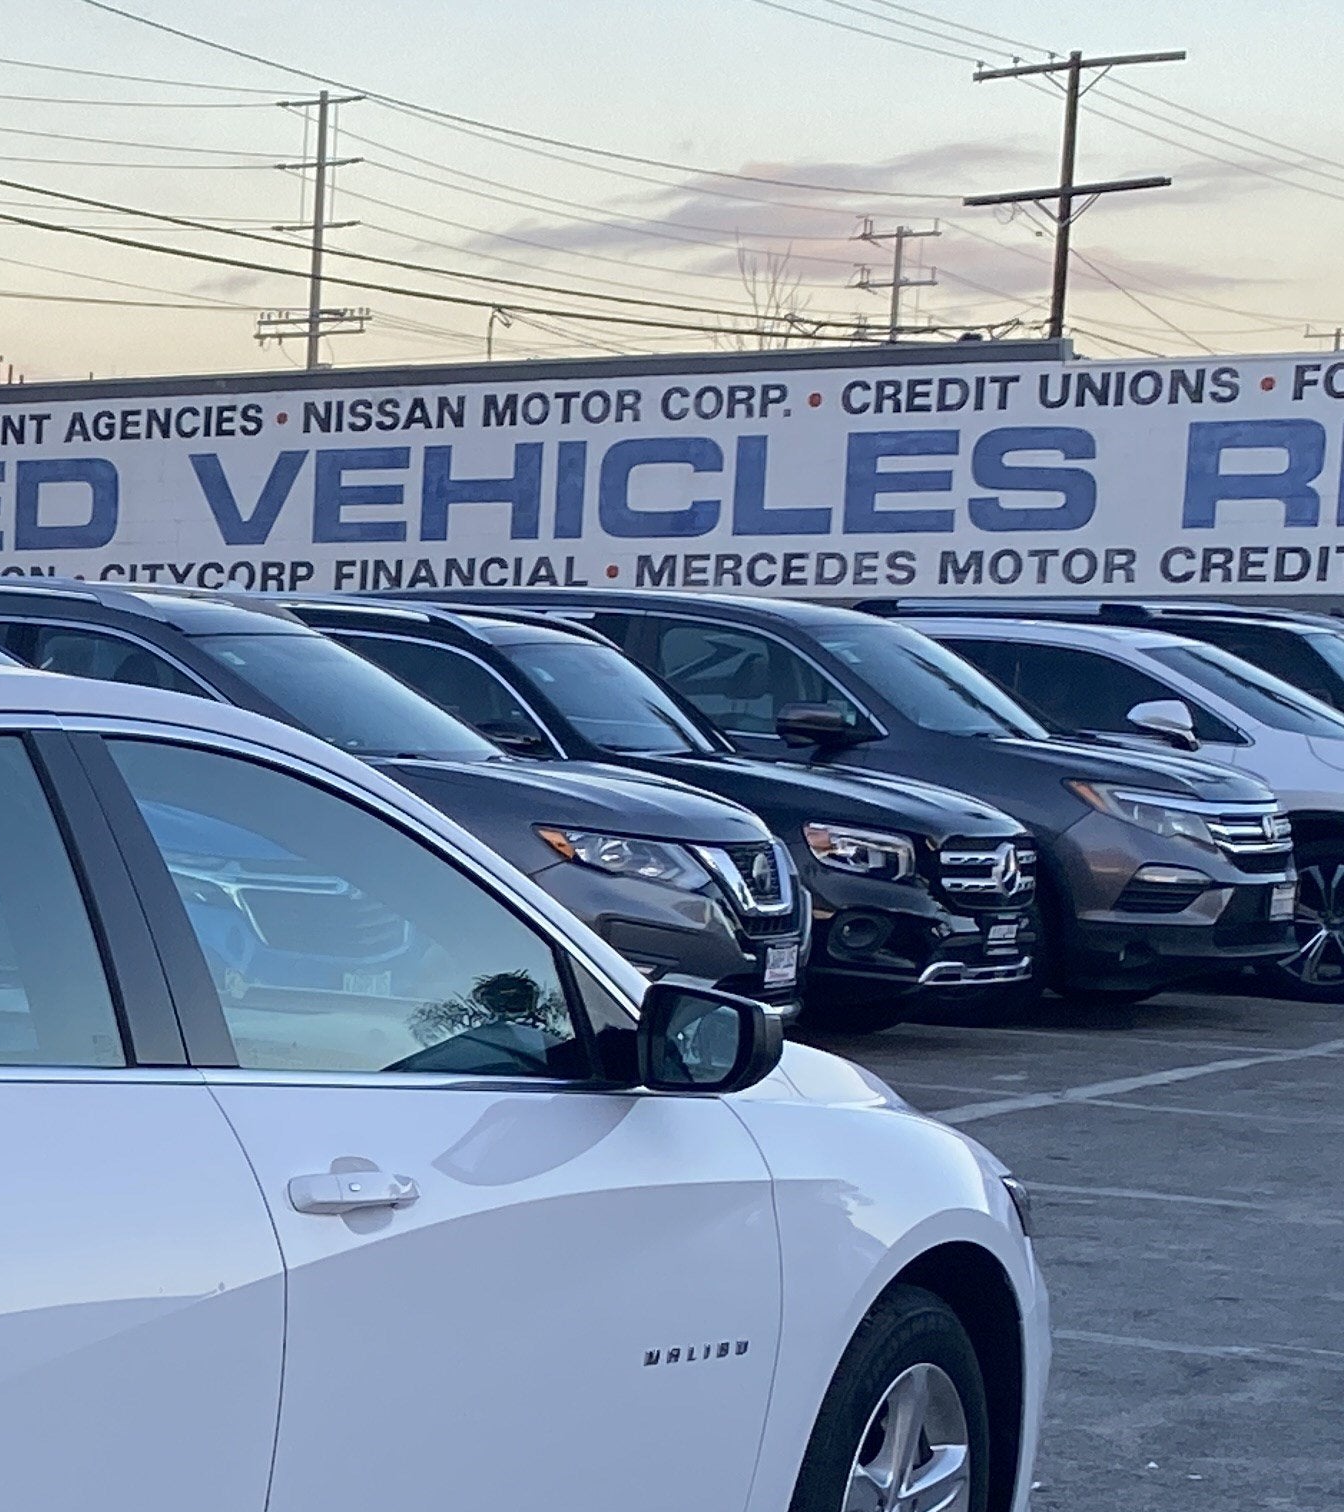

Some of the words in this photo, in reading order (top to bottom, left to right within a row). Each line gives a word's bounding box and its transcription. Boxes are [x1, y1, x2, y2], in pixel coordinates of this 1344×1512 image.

[63, 403, 264, 443] AGENCIES
[302, 395, 467, 433] NISSAN
[482, 389, 643, 427] MOTOR
[661, 384, 792, 421] CORP.
[841, 375, 1021, 414] CREDIT
[1038, 366, 1241, 408] UNIONS
[189, 425, 1098, 546] VEHICLES
[1182, 417, 1344, 530] R
[334, 556, 589, 591] FINANCIAL
[635, 551, 917, 588] MERCEDES
[938, 547, 1137, 585] MOTOR
[643, 1339, 749, 1367] MALIBU
